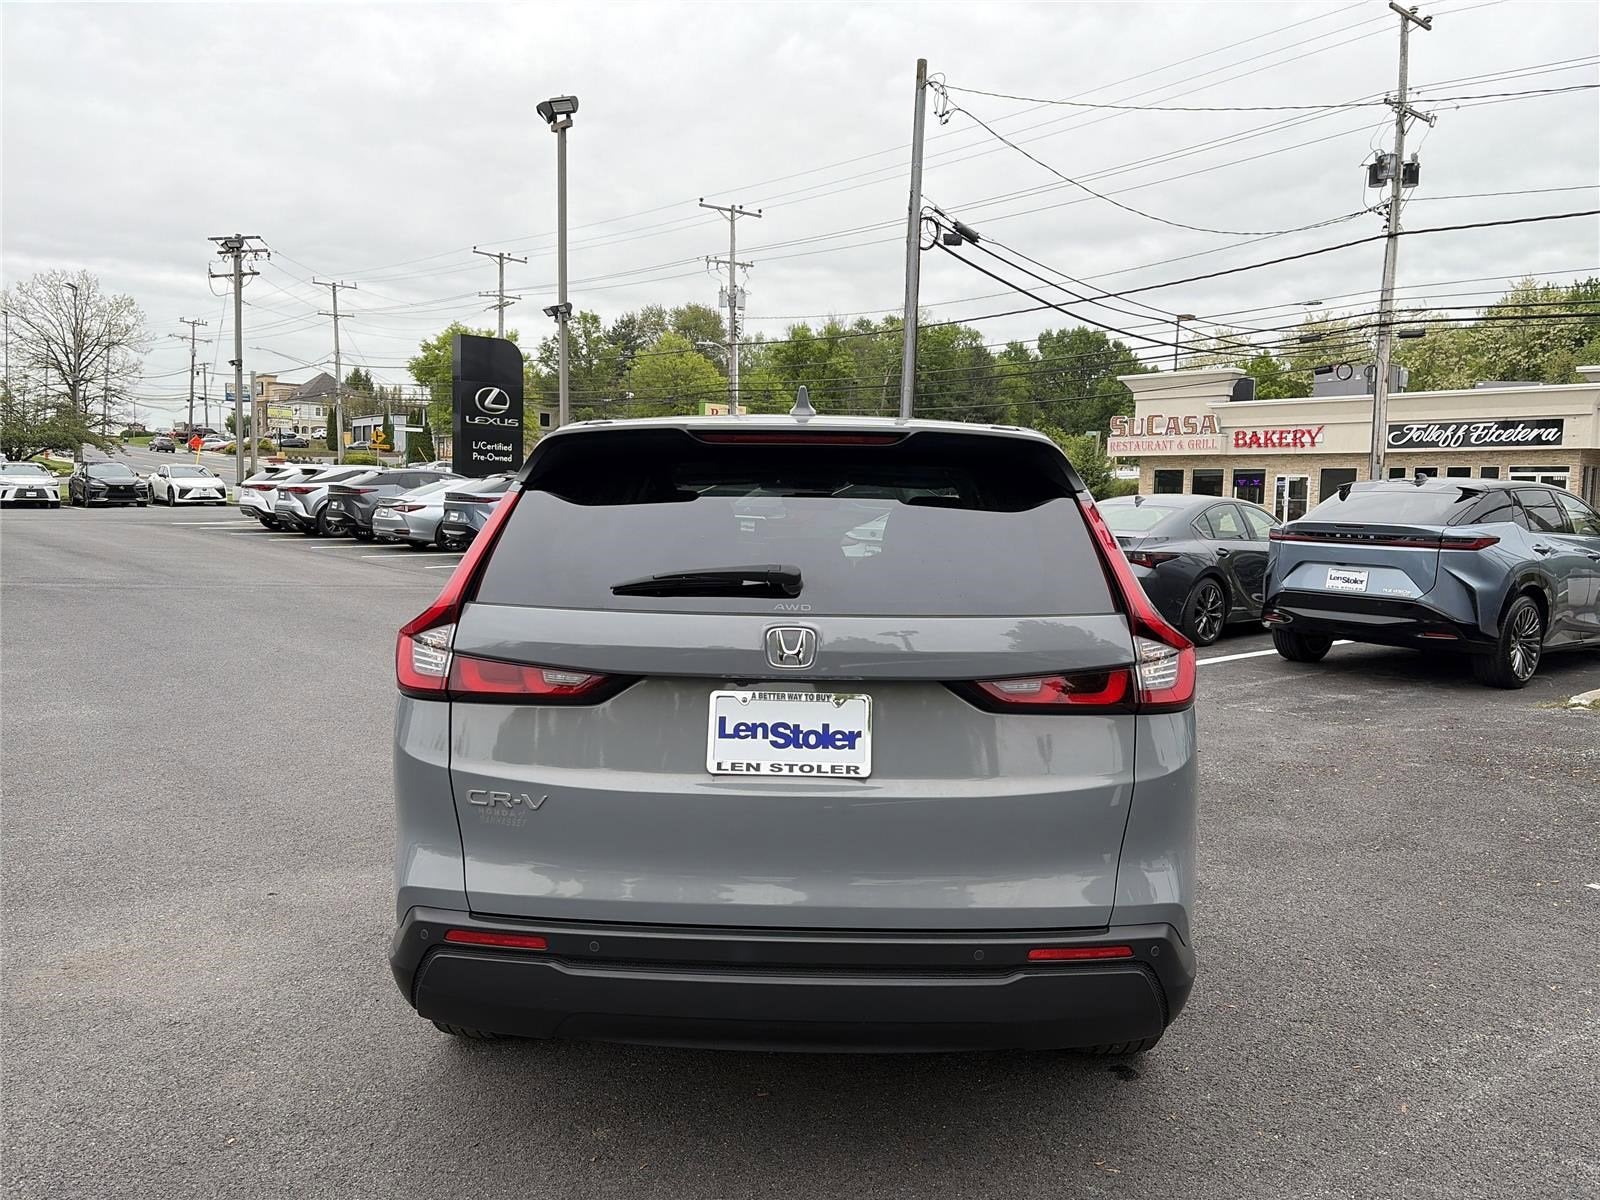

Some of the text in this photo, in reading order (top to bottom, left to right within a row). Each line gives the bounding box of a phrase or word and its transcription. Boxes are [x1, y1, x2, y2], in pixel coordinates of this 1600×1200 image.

[465, 415, 519, 427] LEXUS
[1234, 425, 1325, 449] BAKERY
[1469, 422, 1562, 444] Etcetera
[472, 440, 513, 452] L/Certified
[1110, 439, 1217, 452] RESTAURANT & GRILL
[472, 452, 513, 463] Pre-Owned
[774, 603, 812, 611] AWD
[751, 692, 832, 702] A BETTER WAY TO BUY
[716, 762, 861, 775] LEN STOLER
[465, 789, 548, 811] CR-V
